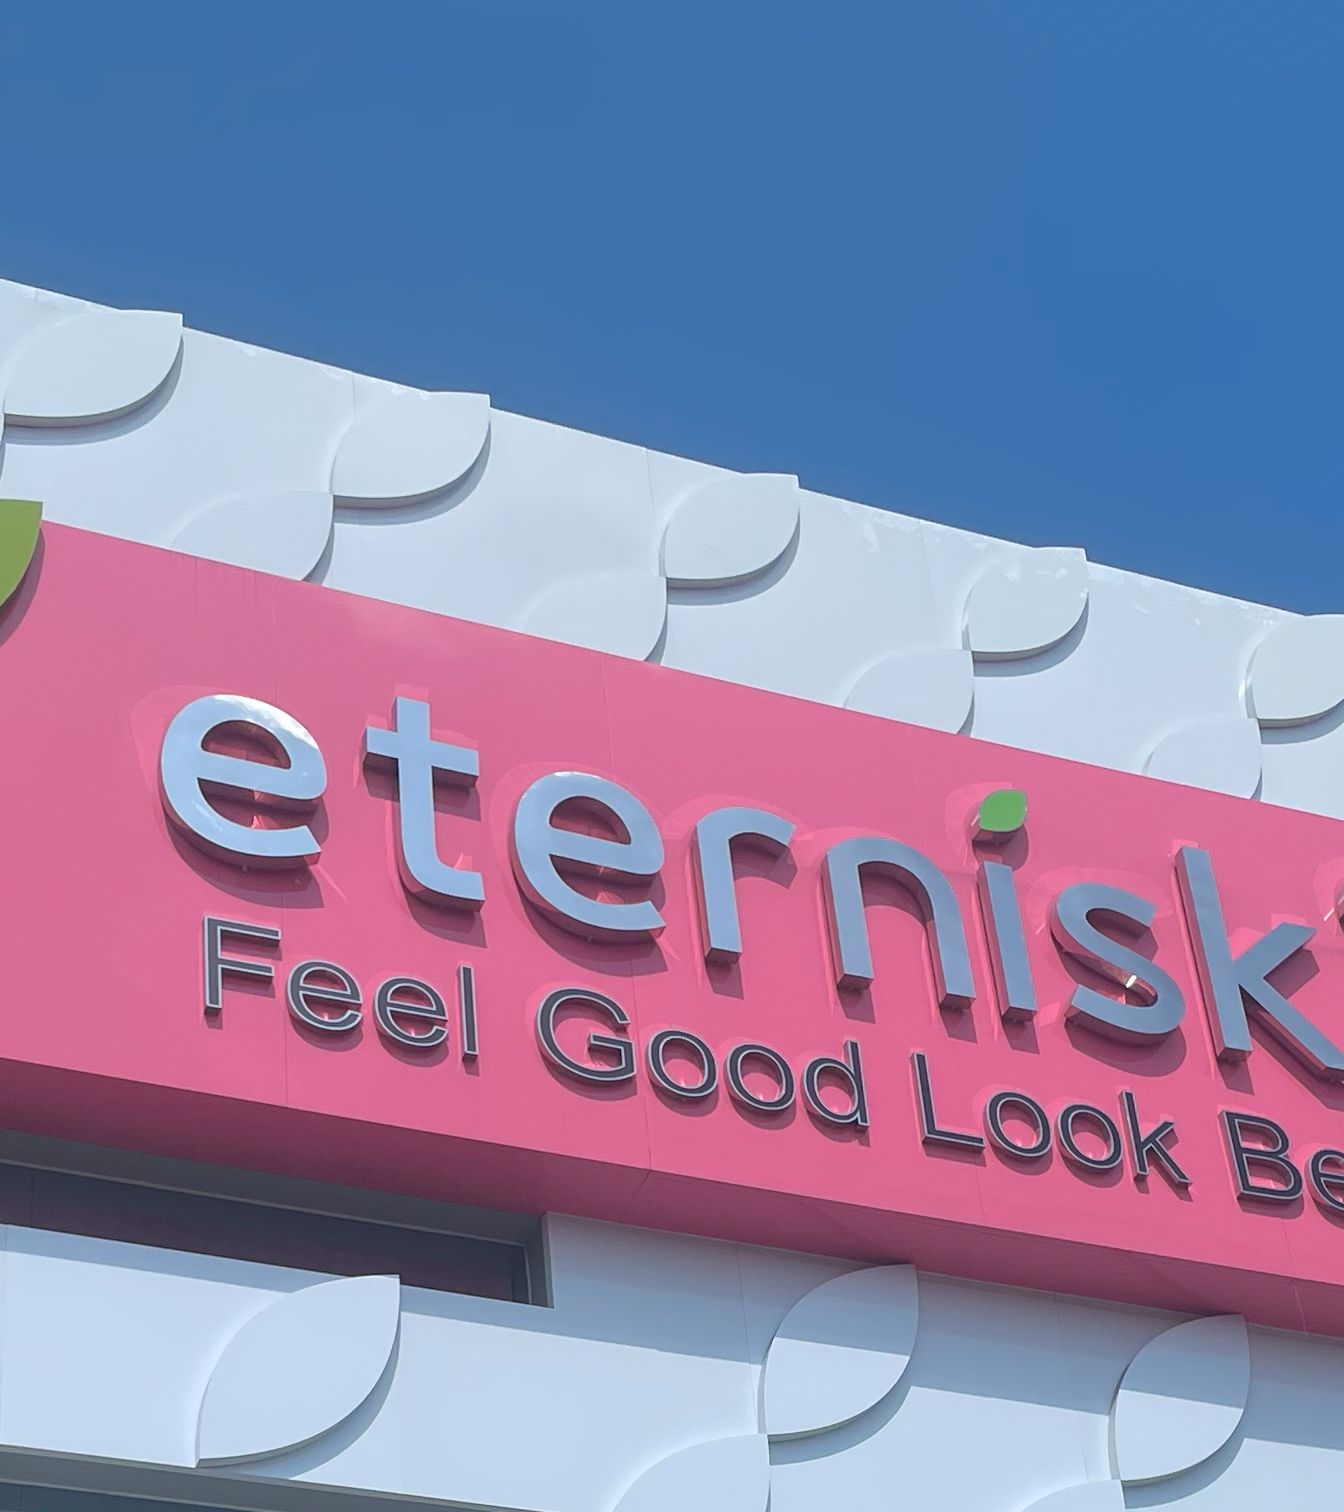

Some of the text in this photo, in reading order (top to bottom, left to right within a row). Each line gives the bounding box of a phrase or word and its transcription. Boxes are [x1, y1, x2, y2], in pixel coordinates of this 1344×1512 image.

[202, 914, 480, 1063] Feel
[536, 987, 871, 1130] Good
[910, 1051, 1193, 1188] Look
